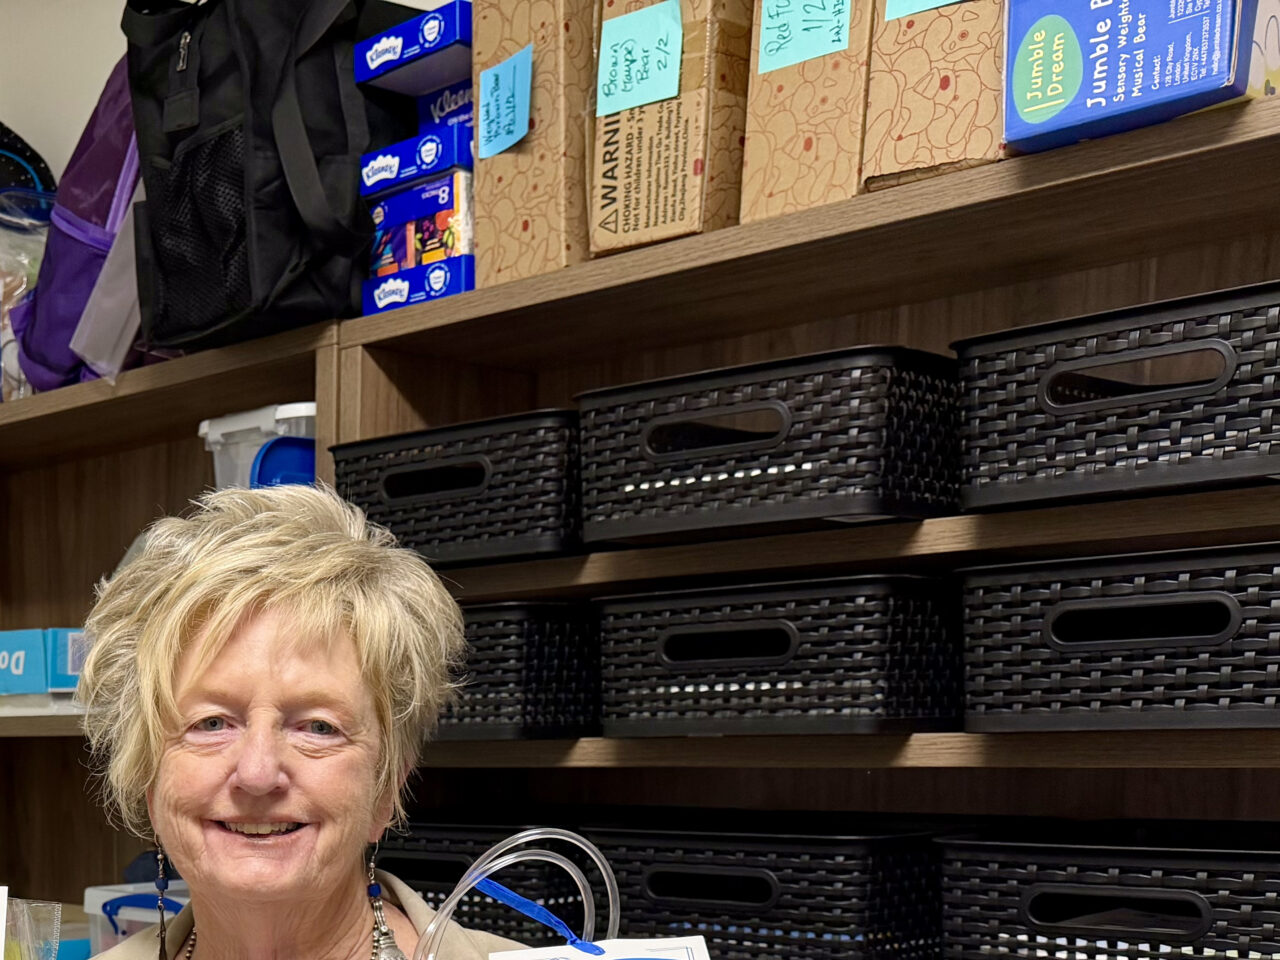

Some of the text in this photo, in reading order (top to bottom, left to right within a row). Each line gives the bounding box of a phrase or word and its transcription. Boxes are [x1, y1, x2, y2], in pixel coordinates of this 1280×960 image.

[655, 32, 671, 70] 2/2
[764, 20, 793, 57] Red
[1113, 0, 1133, 102] Sensory Weight
[1131, 13, 1147, 97] Musical Bear
[635, 48, 650, 84] Bear
[1027, 29, 1046, 100] Jumble
[1047, 32, 1065, 96] Dream
[1086, 18, 1112, 108] Jumble
[1151, 54, 1161, 90] Contact:
[1166, 61, 1175, 75] City
[1182, 61, 1190, 83] United
[431, 89, 474, 123] Kleen
[635, 127, 644, 155] under
[600, 112, 622, 210] WARNI
[633, 157, 642, 195] children
[622, 133, 635, 233] CHOKING HAZARD
[631, 214, 640, 232] Not
[632, 198, 641, 212] for
